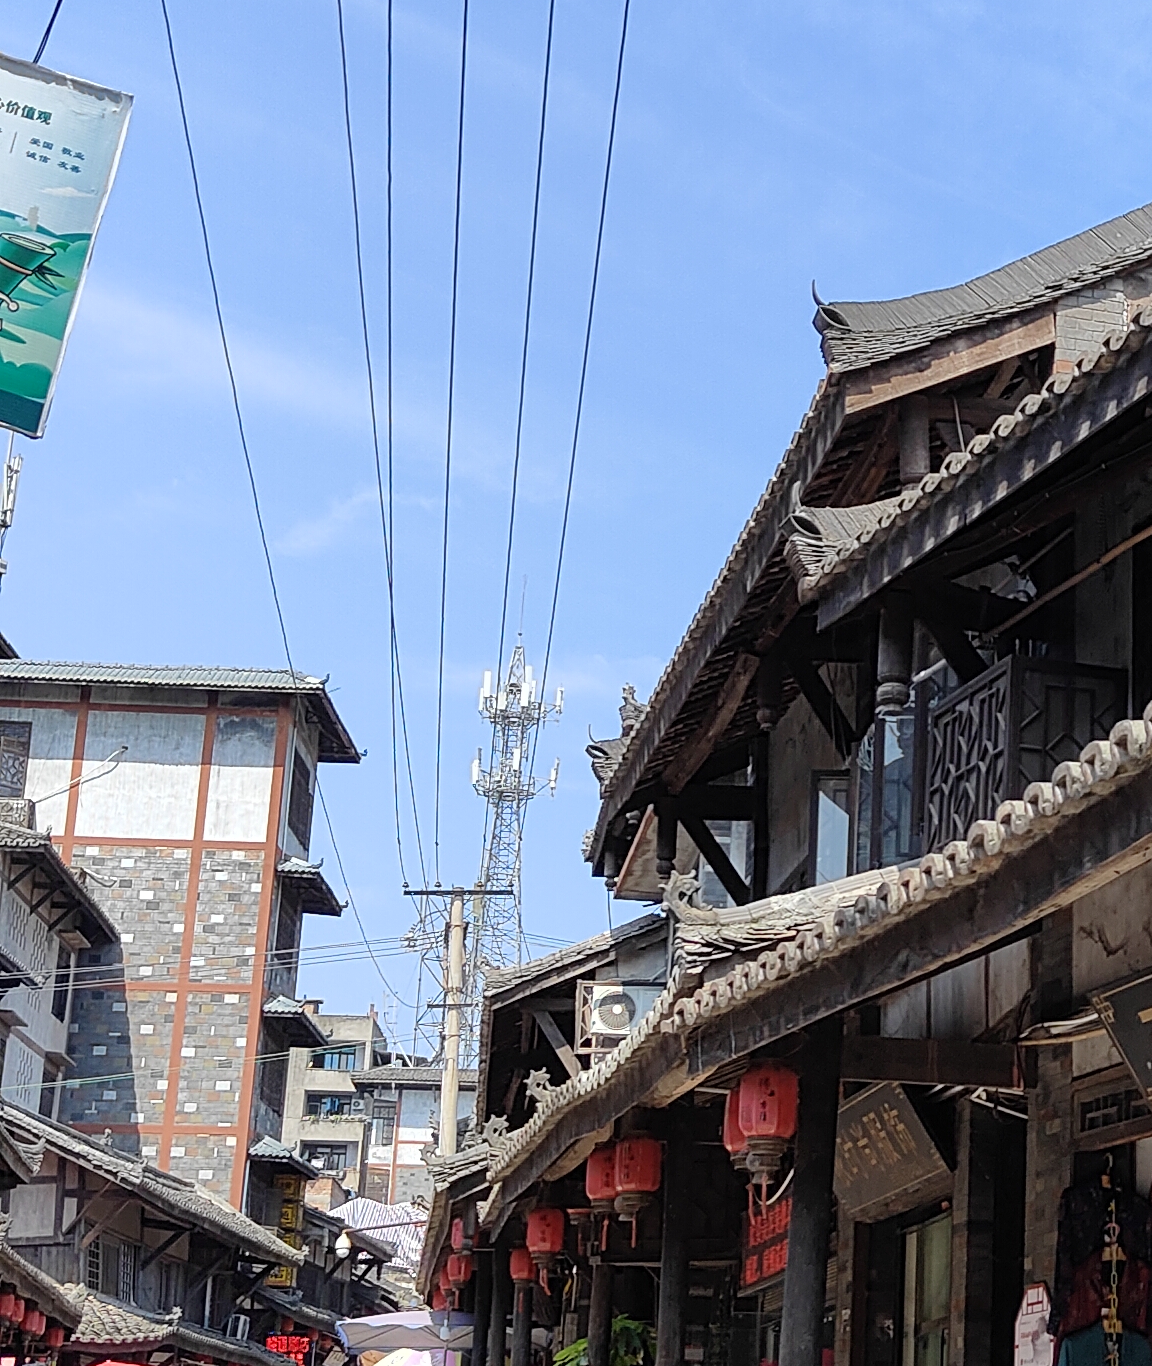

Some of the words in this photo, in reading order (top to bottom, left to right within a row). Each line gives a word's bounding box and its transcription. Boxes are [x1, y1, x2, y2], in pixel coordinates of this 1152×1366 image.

[29, 137, 54, 150] 爱国
[61, 147, 85, 161] 敬业
[26, 150, 51, 164] 诚信
[57, 161, 81, 174] 友善
[836, 1102, 917, 1187] 时尚服饰
